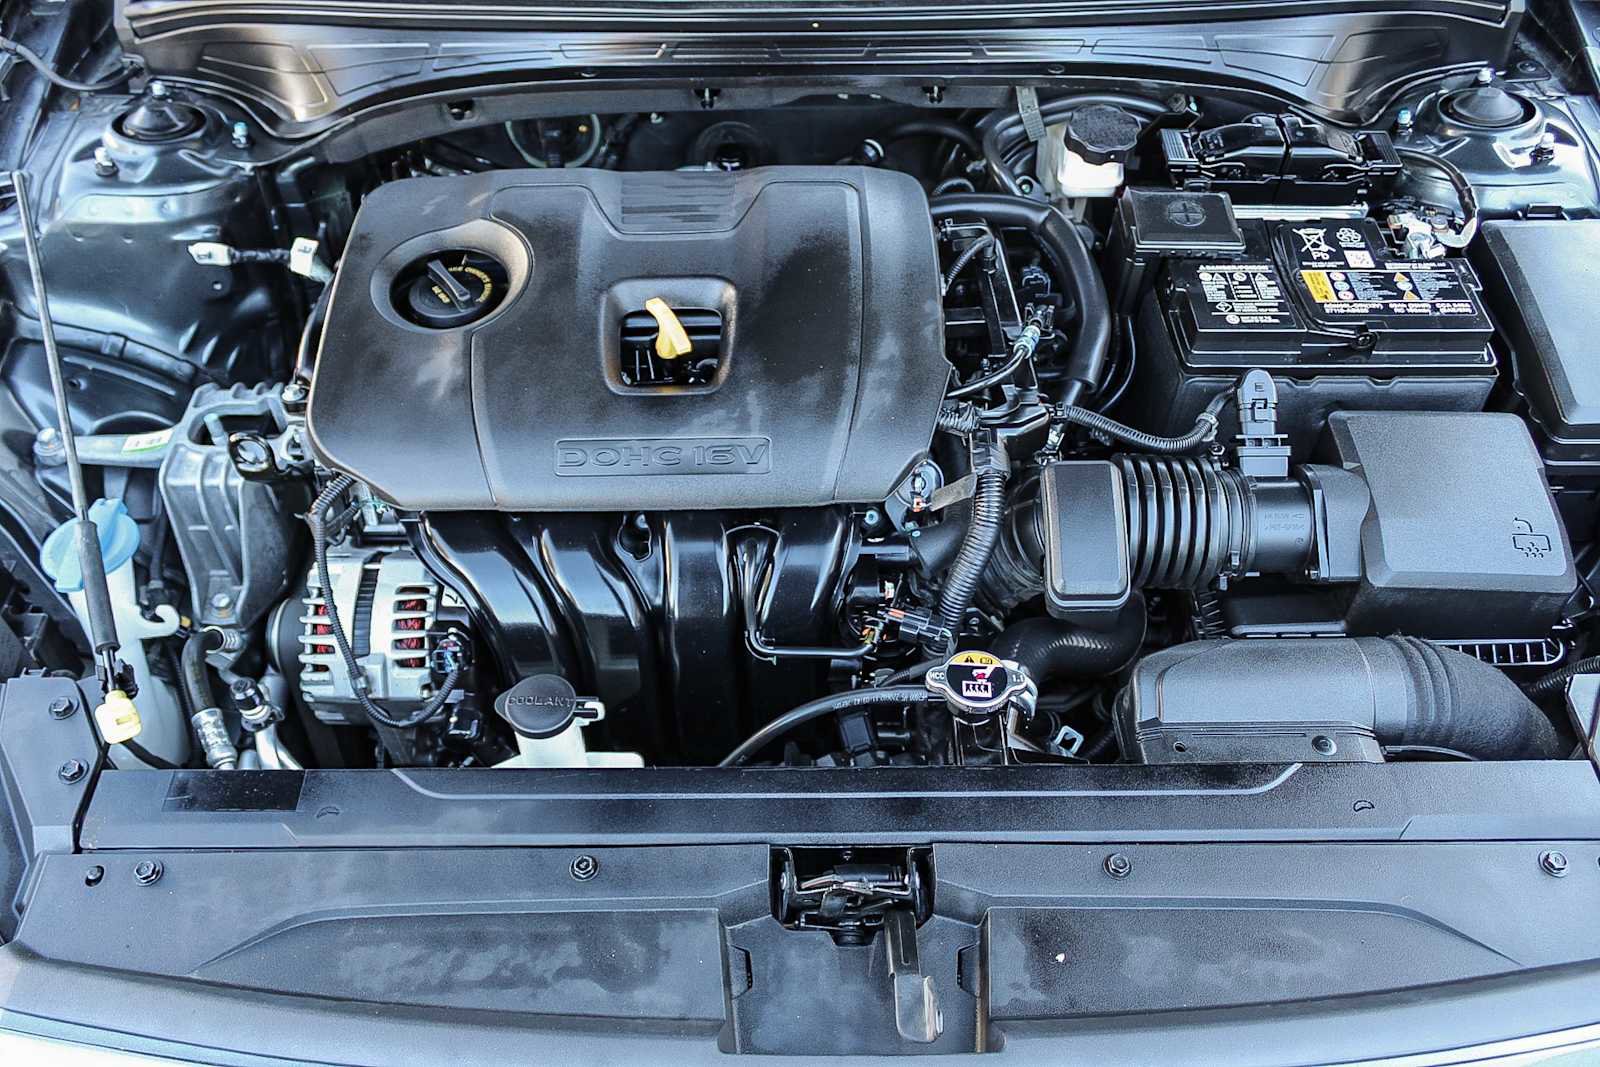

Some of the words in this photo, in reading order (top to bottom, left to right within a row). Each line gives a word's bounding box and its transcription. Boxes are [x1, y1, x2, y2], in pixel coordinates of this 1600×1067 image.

[1312, 251, 1330, 260] Pb
[557, 445, 681, 468] DOHC
[693, 443, 769, 467] 16V
[508, 695, 574, 707] COOLANT
